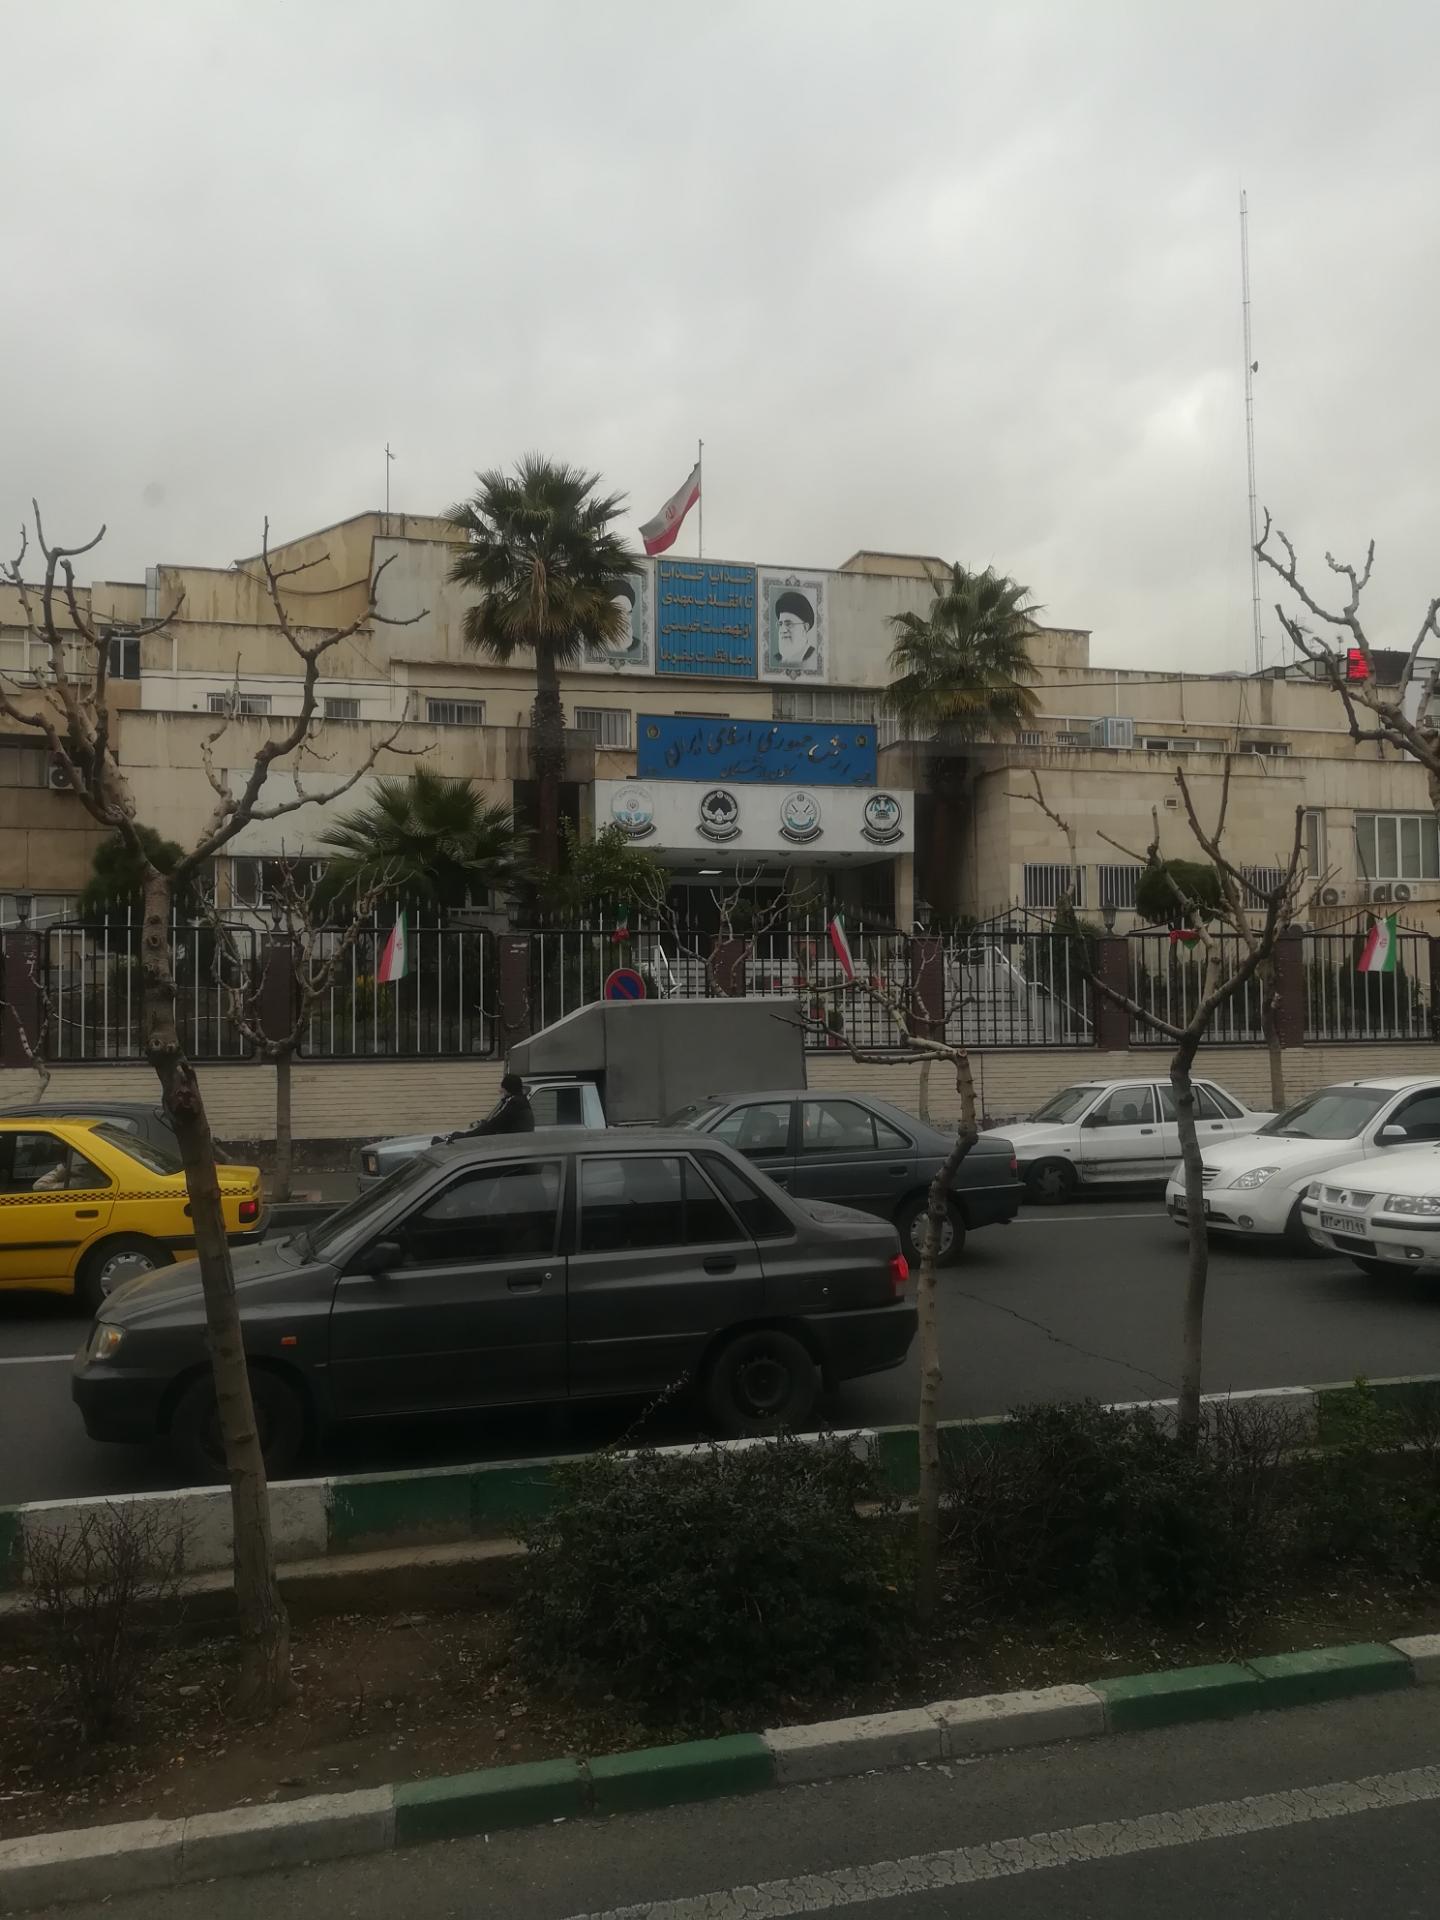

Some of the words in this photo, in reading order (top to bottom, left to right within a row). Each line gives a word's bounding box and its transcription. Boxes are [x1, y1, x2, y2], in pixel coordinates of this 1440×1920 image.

[660, 565, 704, 582] خدایا
[708, 568, 754, 586] خدایا
[662, 592, 694, 607] مهدی
[695, 593, 742, 609] انقلاب
[744, 595, 753, 608] تا
[665, 727, 702, 768] ایران
[708, 725, 751, 754] اسلامی
[758, 727, 812, 758] جمهوری
[807, 734, 851, 776] ارتش
